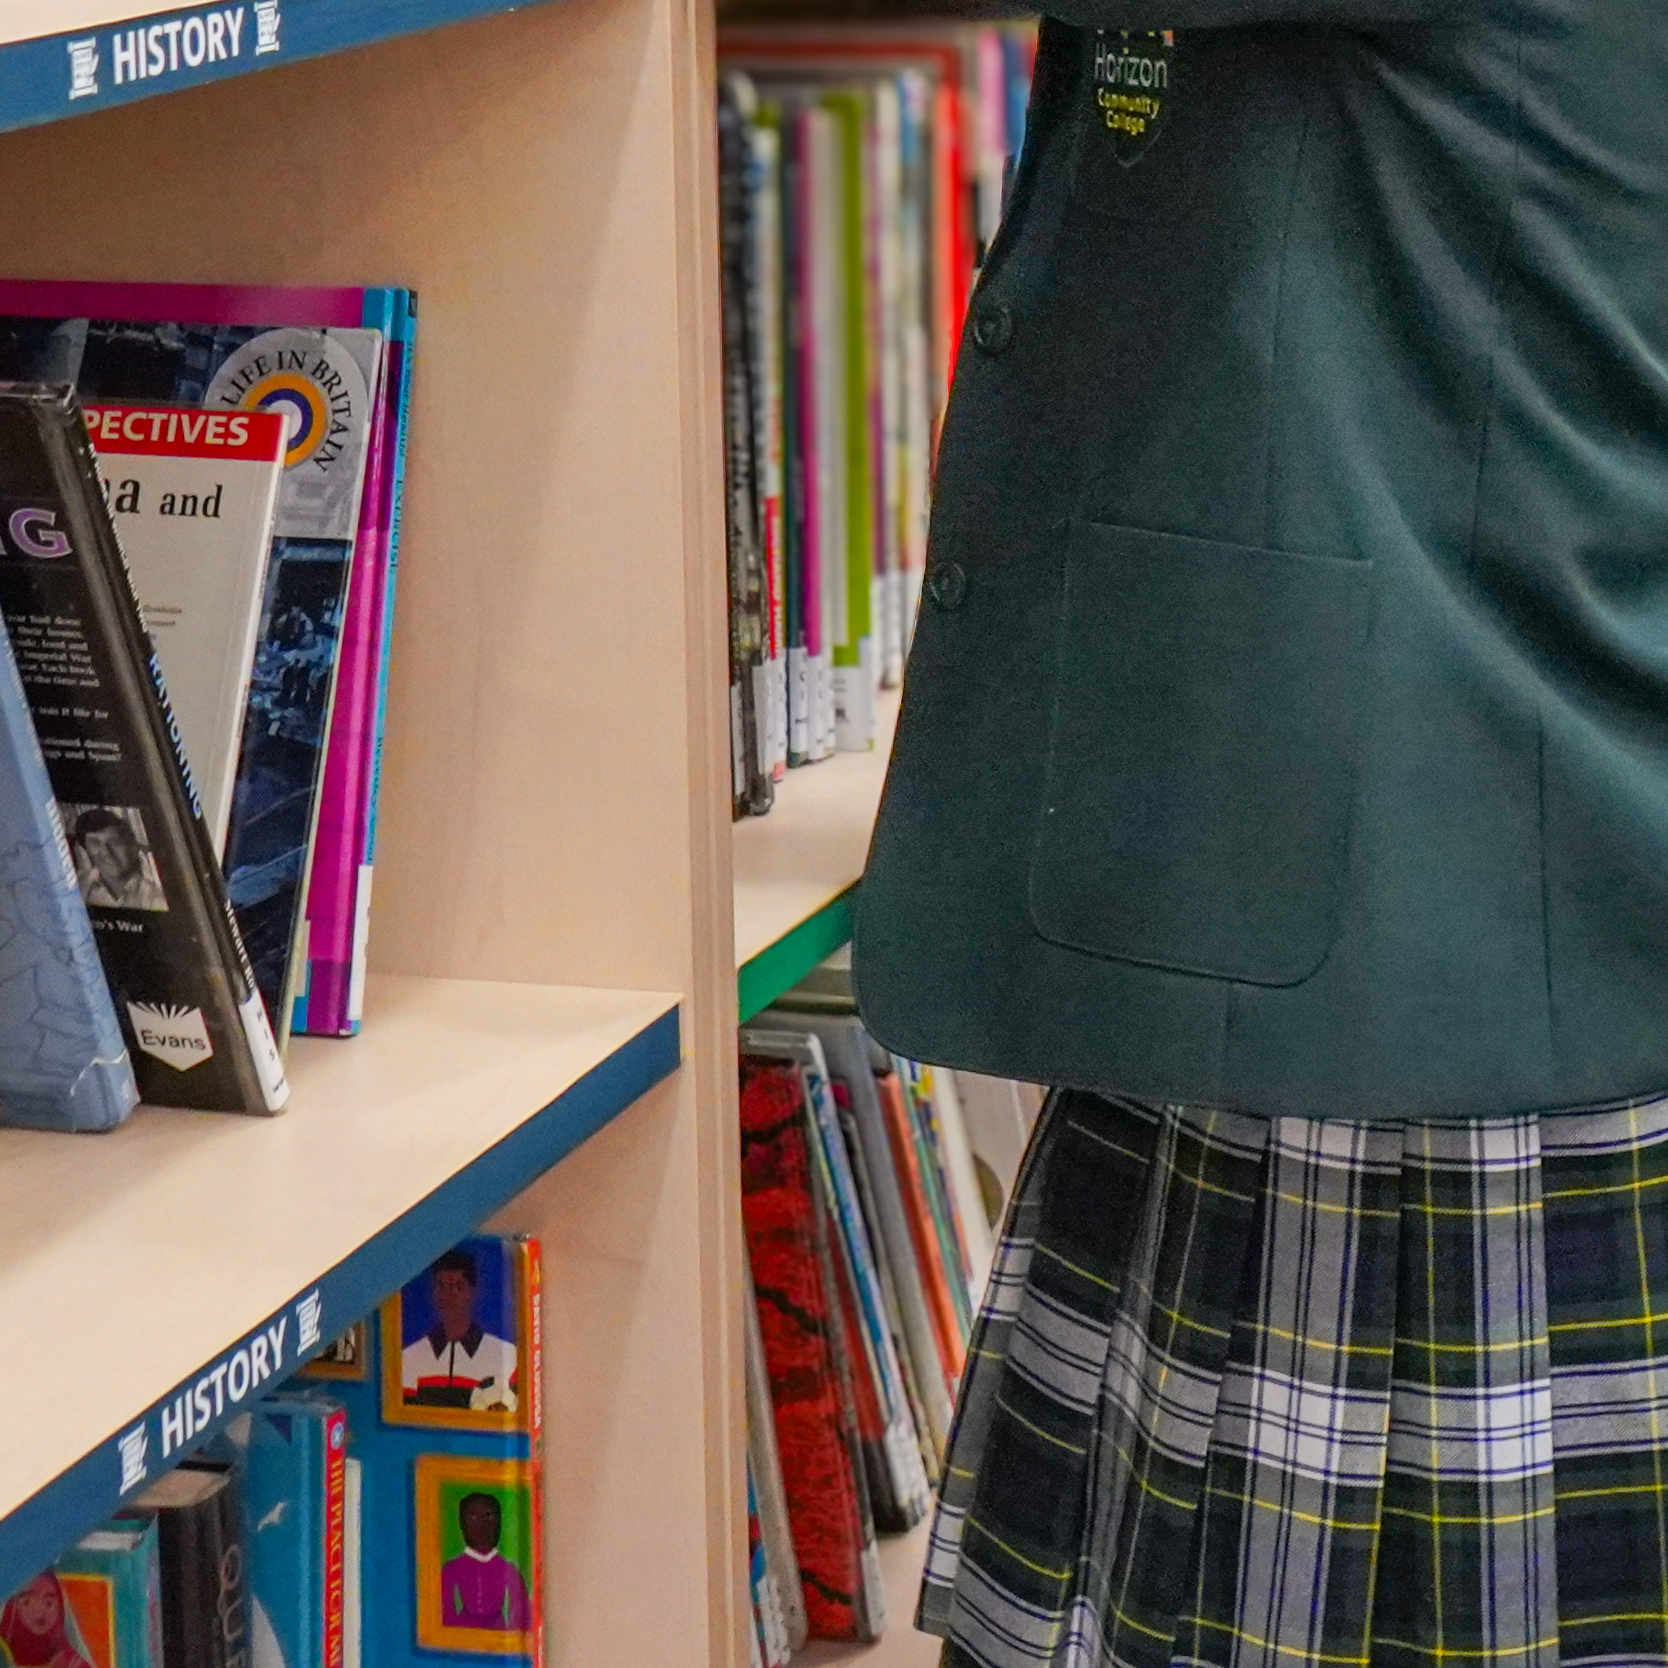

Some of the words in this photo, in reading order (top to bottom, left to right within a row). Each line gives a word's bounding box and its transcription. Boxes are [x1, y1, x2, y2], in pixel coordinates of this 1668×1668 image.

[113, 7, 244, 84] HISTORY
[1094, 42, 1168, 89] Horizon
[83, 409, 249, 447] PECTIVES
[219, 355, 273, 407] LIFE
[276, 349, 309, 371] IN
[310, 357, 353, 474] BRITAIN
[159, 484, 223, 519] and
[119, 921, 144, 934] War
[218, 897, 253, 964] Stewart
[141, 1029, 206, 1051] Evans
[257, 1011, 277, 1061] HIS
[161, 1316, 289, 1458] HISTORY
[327, 1501, 344, 1574] PLACE
[328, 1578, 343, 1628] FOR
